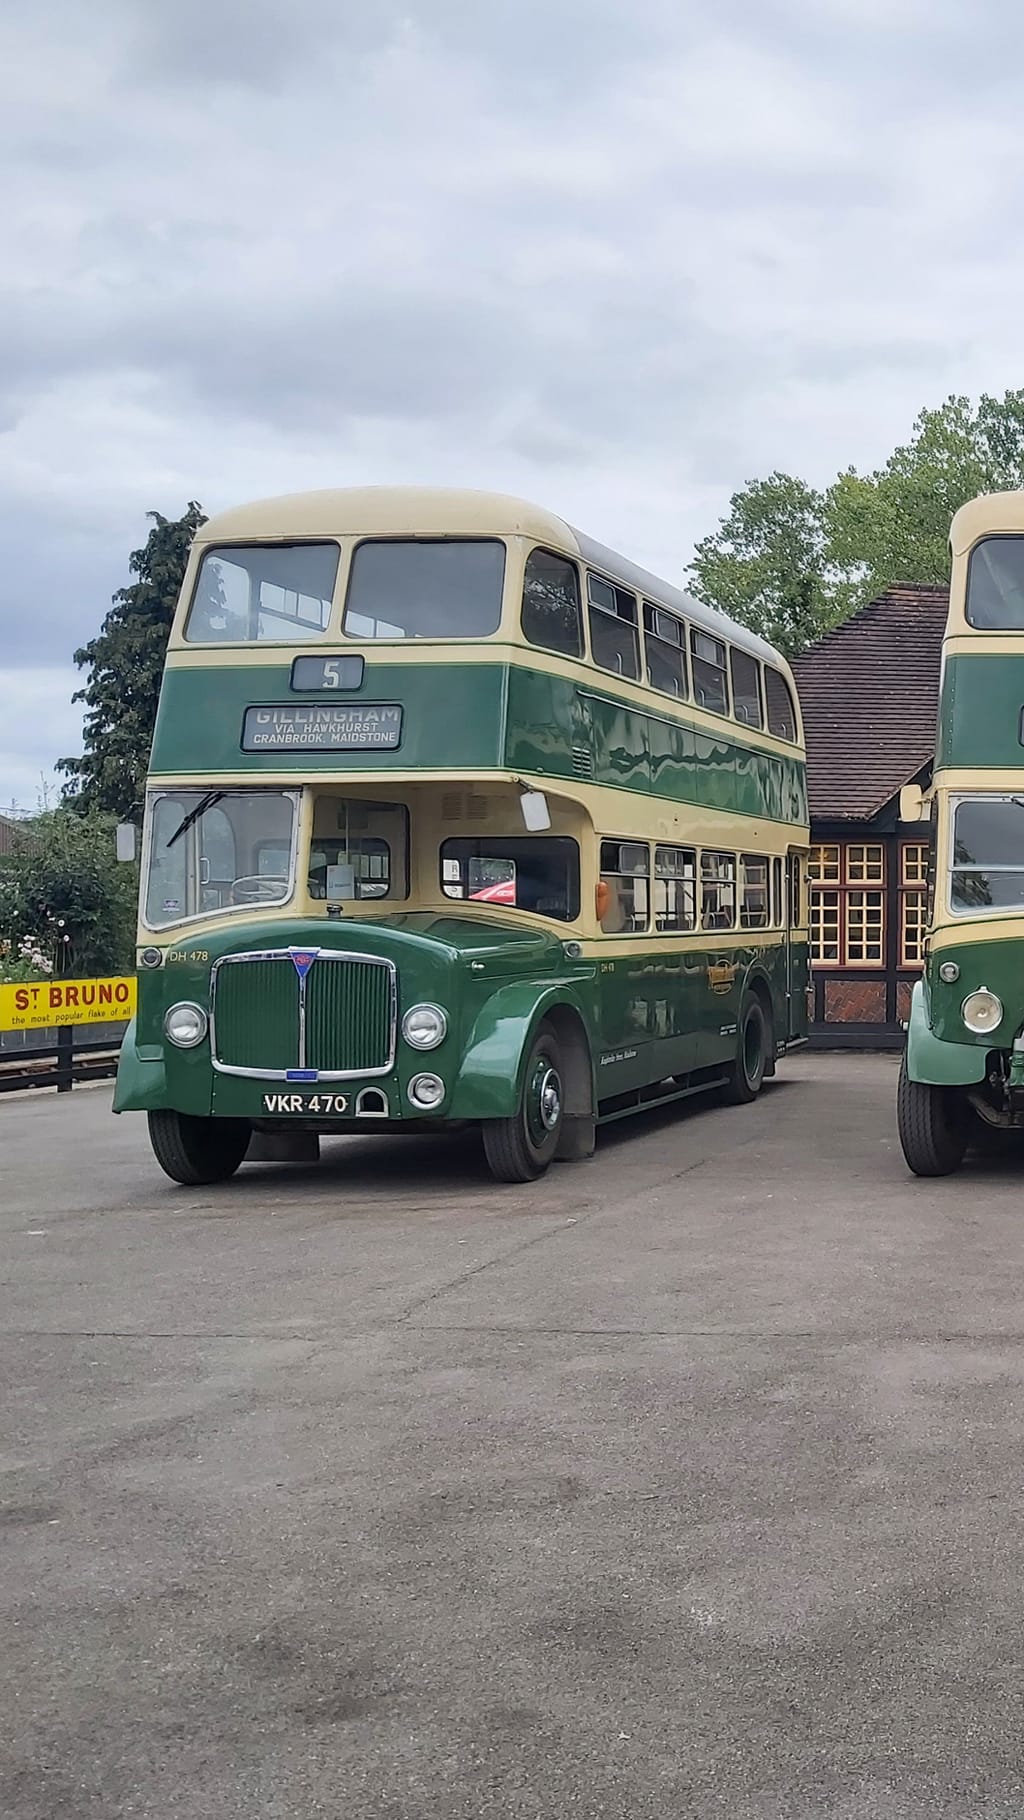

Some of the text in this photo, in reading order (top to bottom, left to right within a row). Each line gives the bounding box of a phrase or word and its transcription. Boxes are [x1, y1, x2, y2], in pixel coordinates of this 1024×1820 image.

[322, 661, 340, 688] 5
[256, 709, 398, 724] GILLINGHAM
[275, 722, 379, 734] VIA HAWKHURST
[330, 731, 397, 743] MAIDSTONE
[169, 951, 209, 962] DH 478
[49, 983, 129, 1009] BRUNO
[12, 1006, 131, 1024] the most popular flake of all
[264, 1094, 347, 1112] VKR 470
